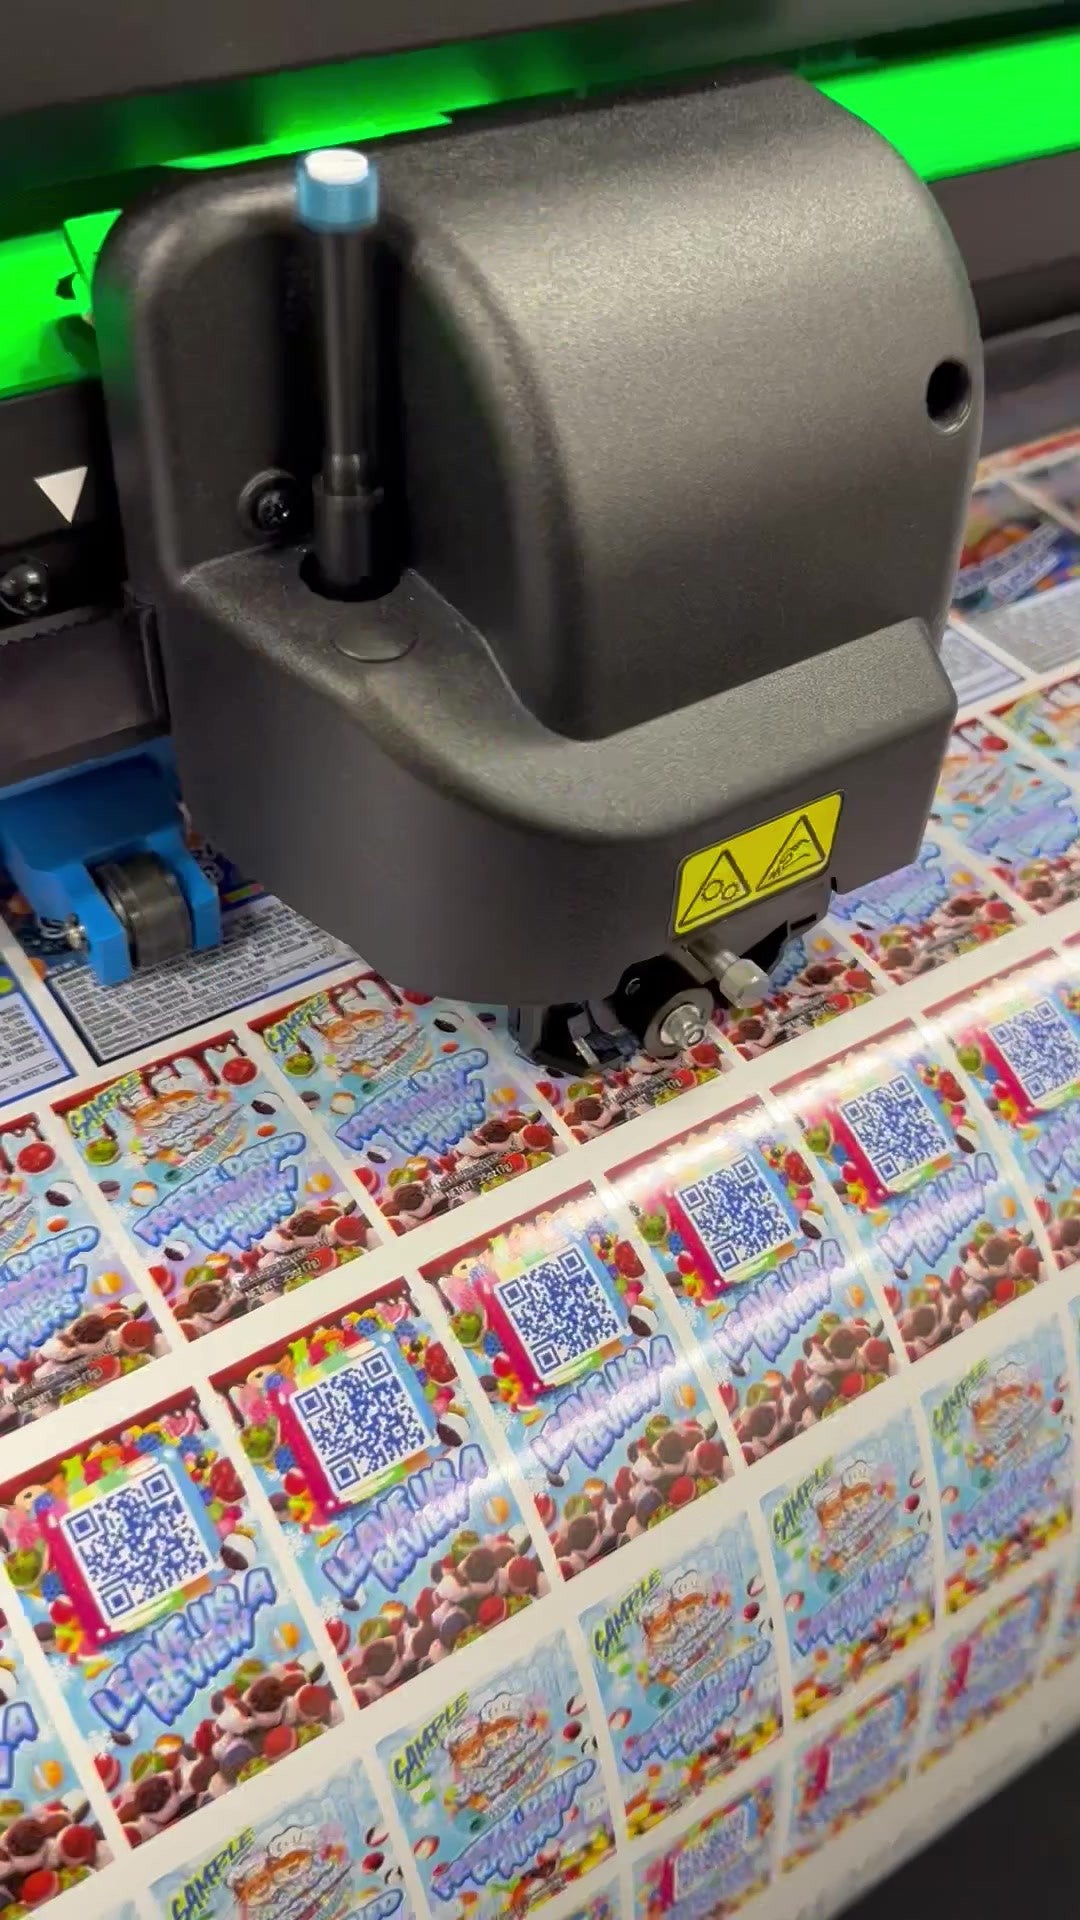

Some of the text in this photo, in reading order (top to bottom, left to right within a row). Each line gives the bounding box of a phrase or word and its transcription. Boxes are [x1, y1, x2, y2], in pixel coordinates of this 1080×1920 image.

[975, 1152, 998, 1185] A
[713, 1238, 846, 1363] LEAVE US A
[530, 1334, 676, 1474] LEAVE US A
[322, 1442, 489, 1600] LEAVE US A
[370, 1479, 470, 1593] REVIEW
[90, 1566, 278, 1732] LEAVE US A
[146, 1604, 256, 1727] REVIEW
[3, 1701, 39, 1743] A
[393, 1691, 470, 1787] SAMPLE
[168, 1826, 257, 1920] SAMPLE
